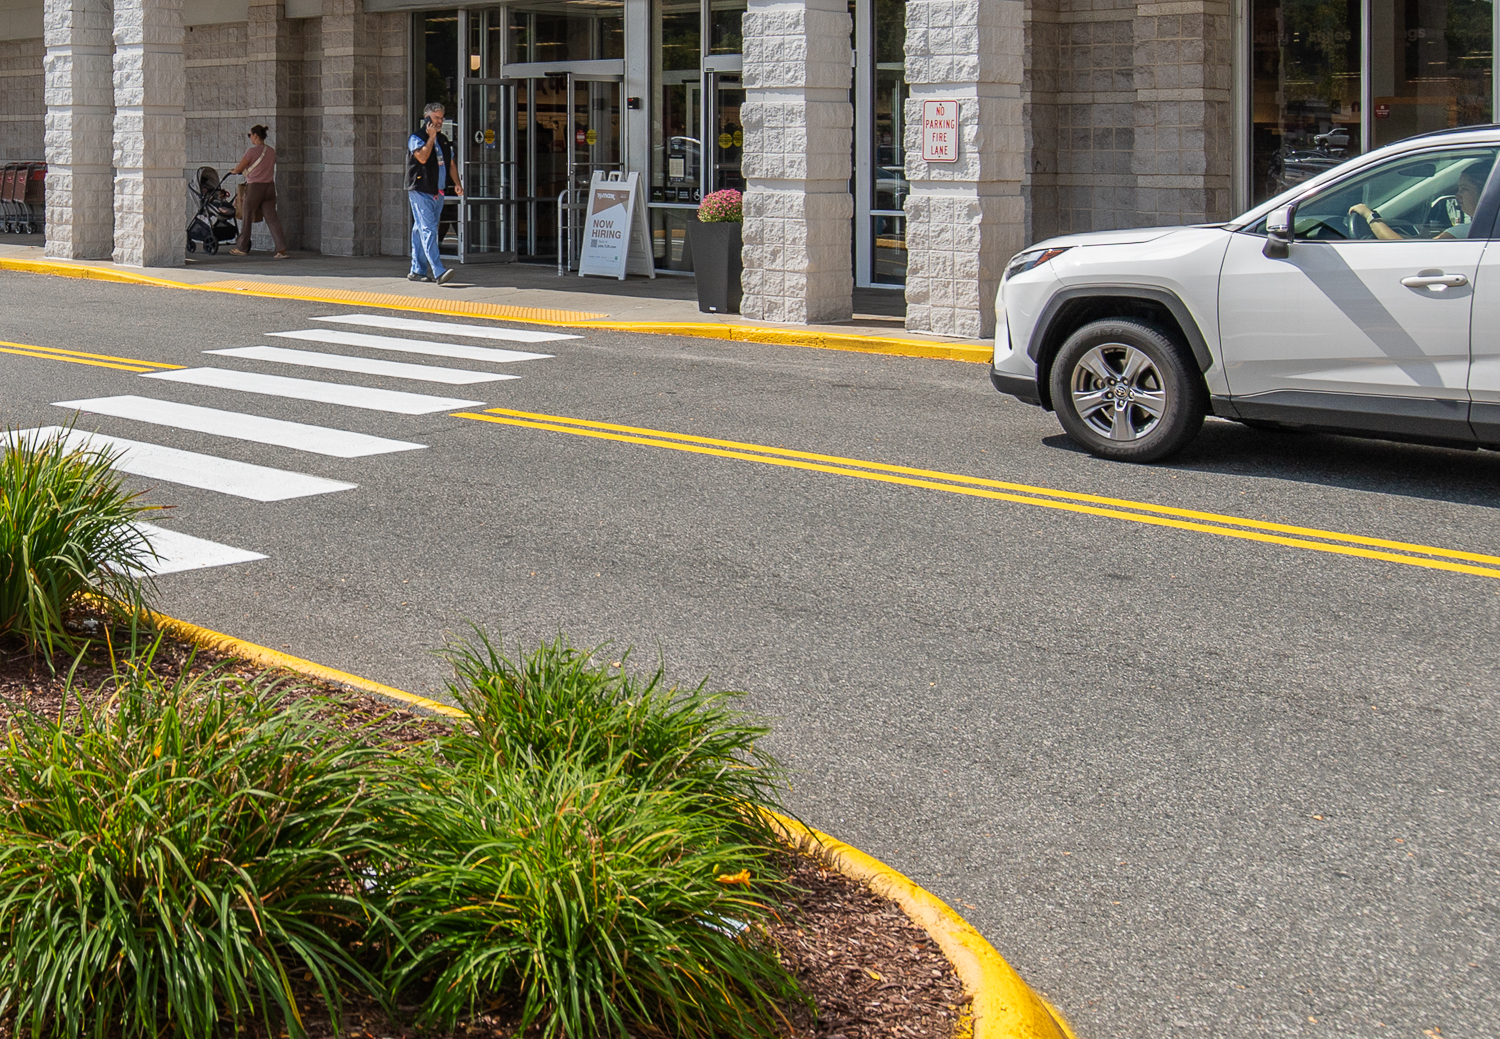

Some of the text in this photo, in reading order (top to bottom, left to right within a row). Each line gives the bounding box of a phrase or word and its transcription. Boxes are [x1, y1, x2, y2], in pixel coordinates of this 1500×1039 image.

[936, 106, 945, 116] NO
[925, 119, 955, 129] PARKING
[932, 132, 947, 142] FIRE
[930, 145, 948, 155] LANE
[592, 219, 614, 228] NOW
[591, 229, 621, 239] HIRING
